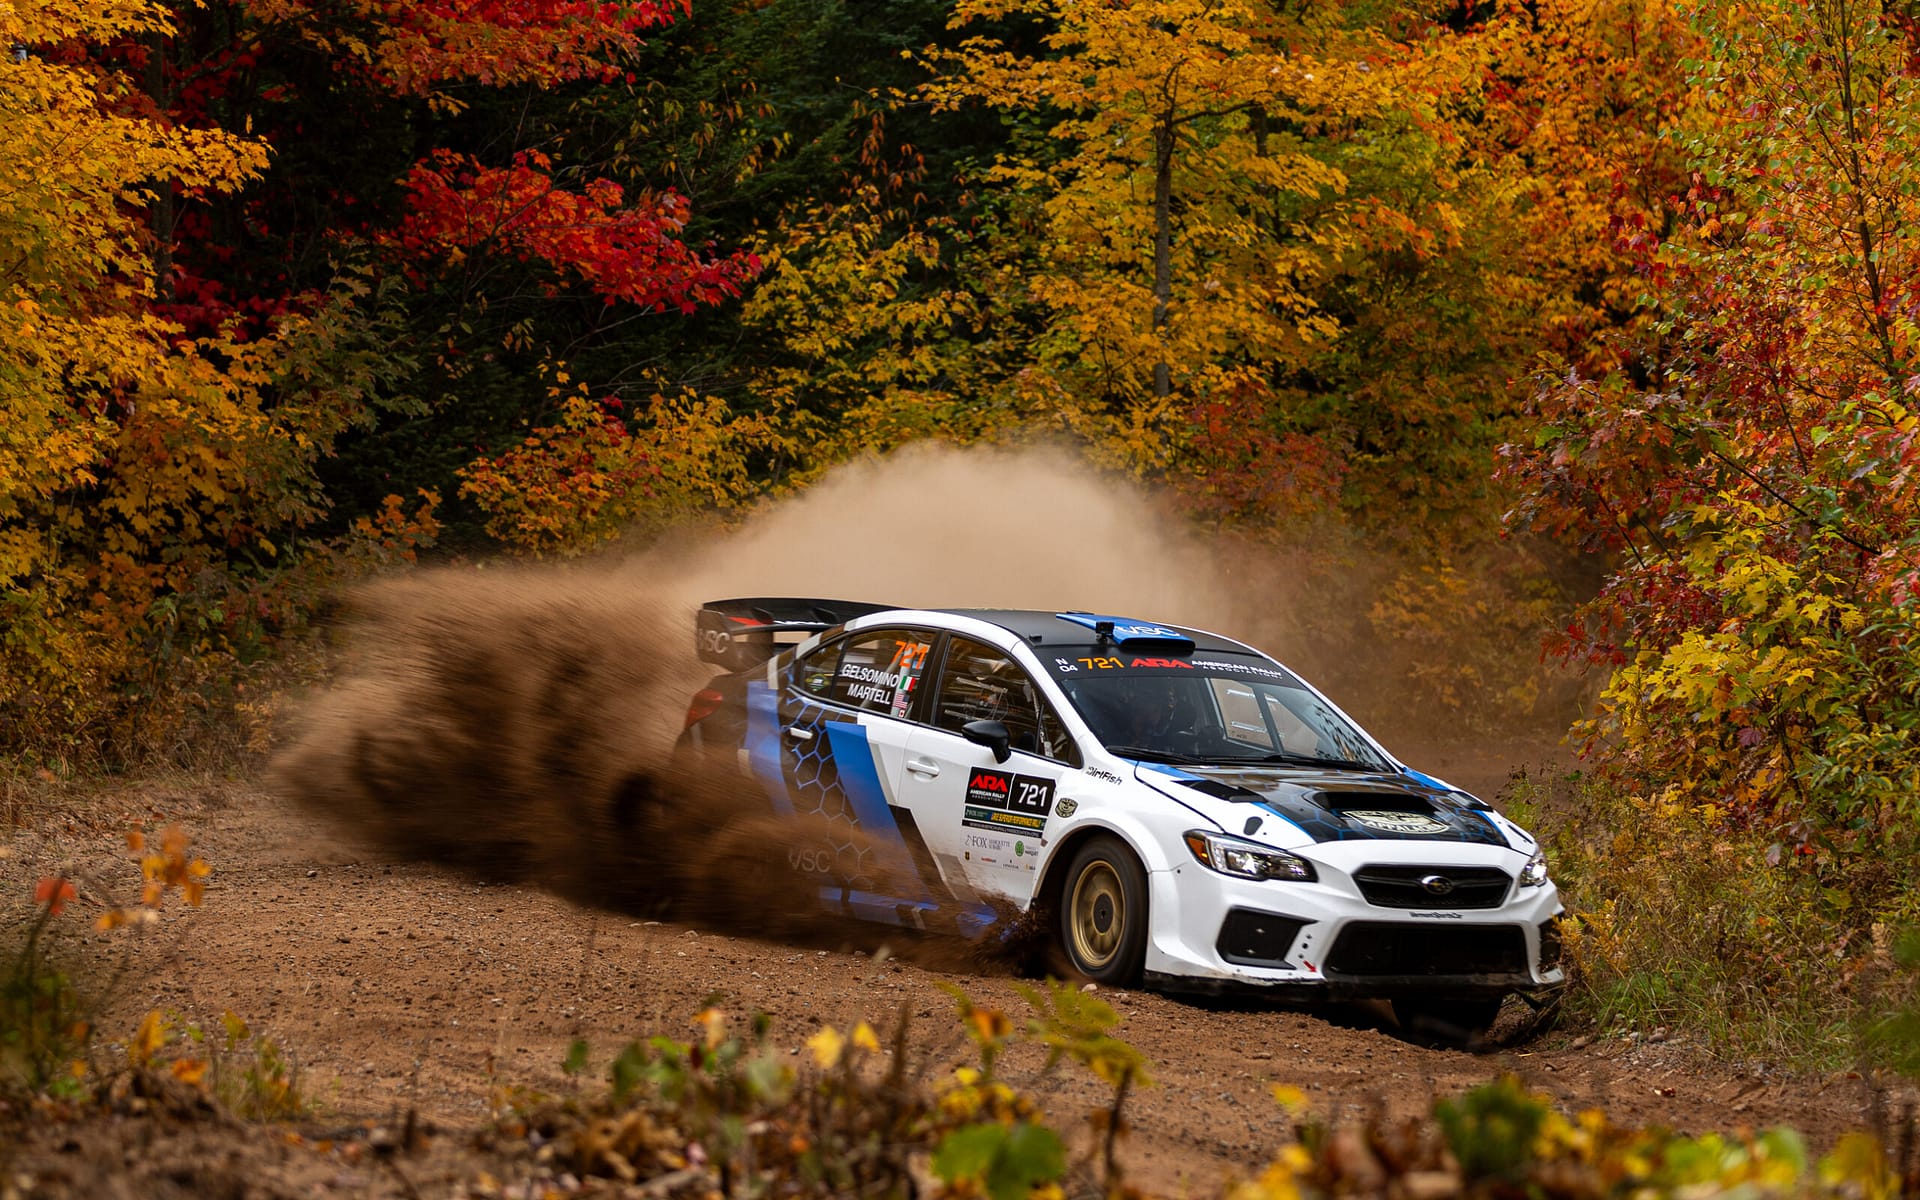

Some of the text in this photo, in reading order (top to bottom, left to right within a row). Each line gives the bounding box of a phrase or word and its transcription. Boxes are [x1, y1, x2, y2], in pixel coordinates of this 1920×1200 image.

[890, 640, 928, 670] 721
[1055, 657, 1069, 665] N
[1059, 664, 1079, 672] 04
[1077, 656, 1125, 670] 721
[1130, 657, 1195, 669] ARA
[1191, 660, 1248, 671] AMERICAN
[841, 664, 900, 688] GELSOMINO
[847, 683, 892, 705] MARTELL
[969, 773, 1009, 793] ARA
[970, 788, 992, 797] AMERICAN
[1018, 782, 1048, 808] 721
[972, 835, 988, 848] FOX
[788, 848, 831, 873] VSC
